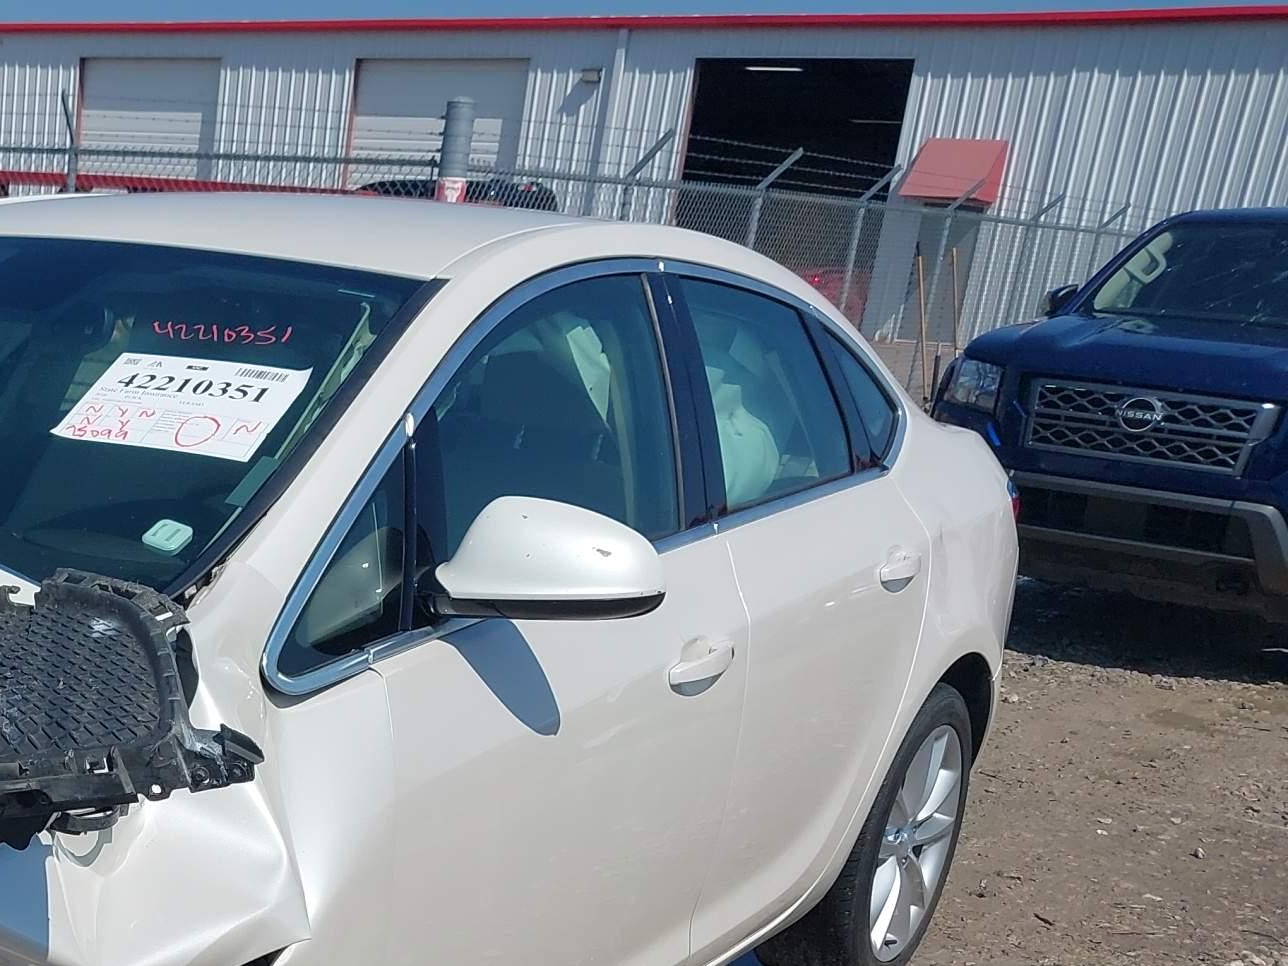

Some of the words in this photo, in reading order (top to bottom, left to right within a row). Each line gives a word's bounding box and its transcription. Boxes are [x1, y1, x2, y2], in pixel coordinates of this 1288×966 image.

[153, 321, 292, 345] 42210351
[117, 372, 270, 403] 42210351
[1115, 409, 1163, 420] NISSAN
